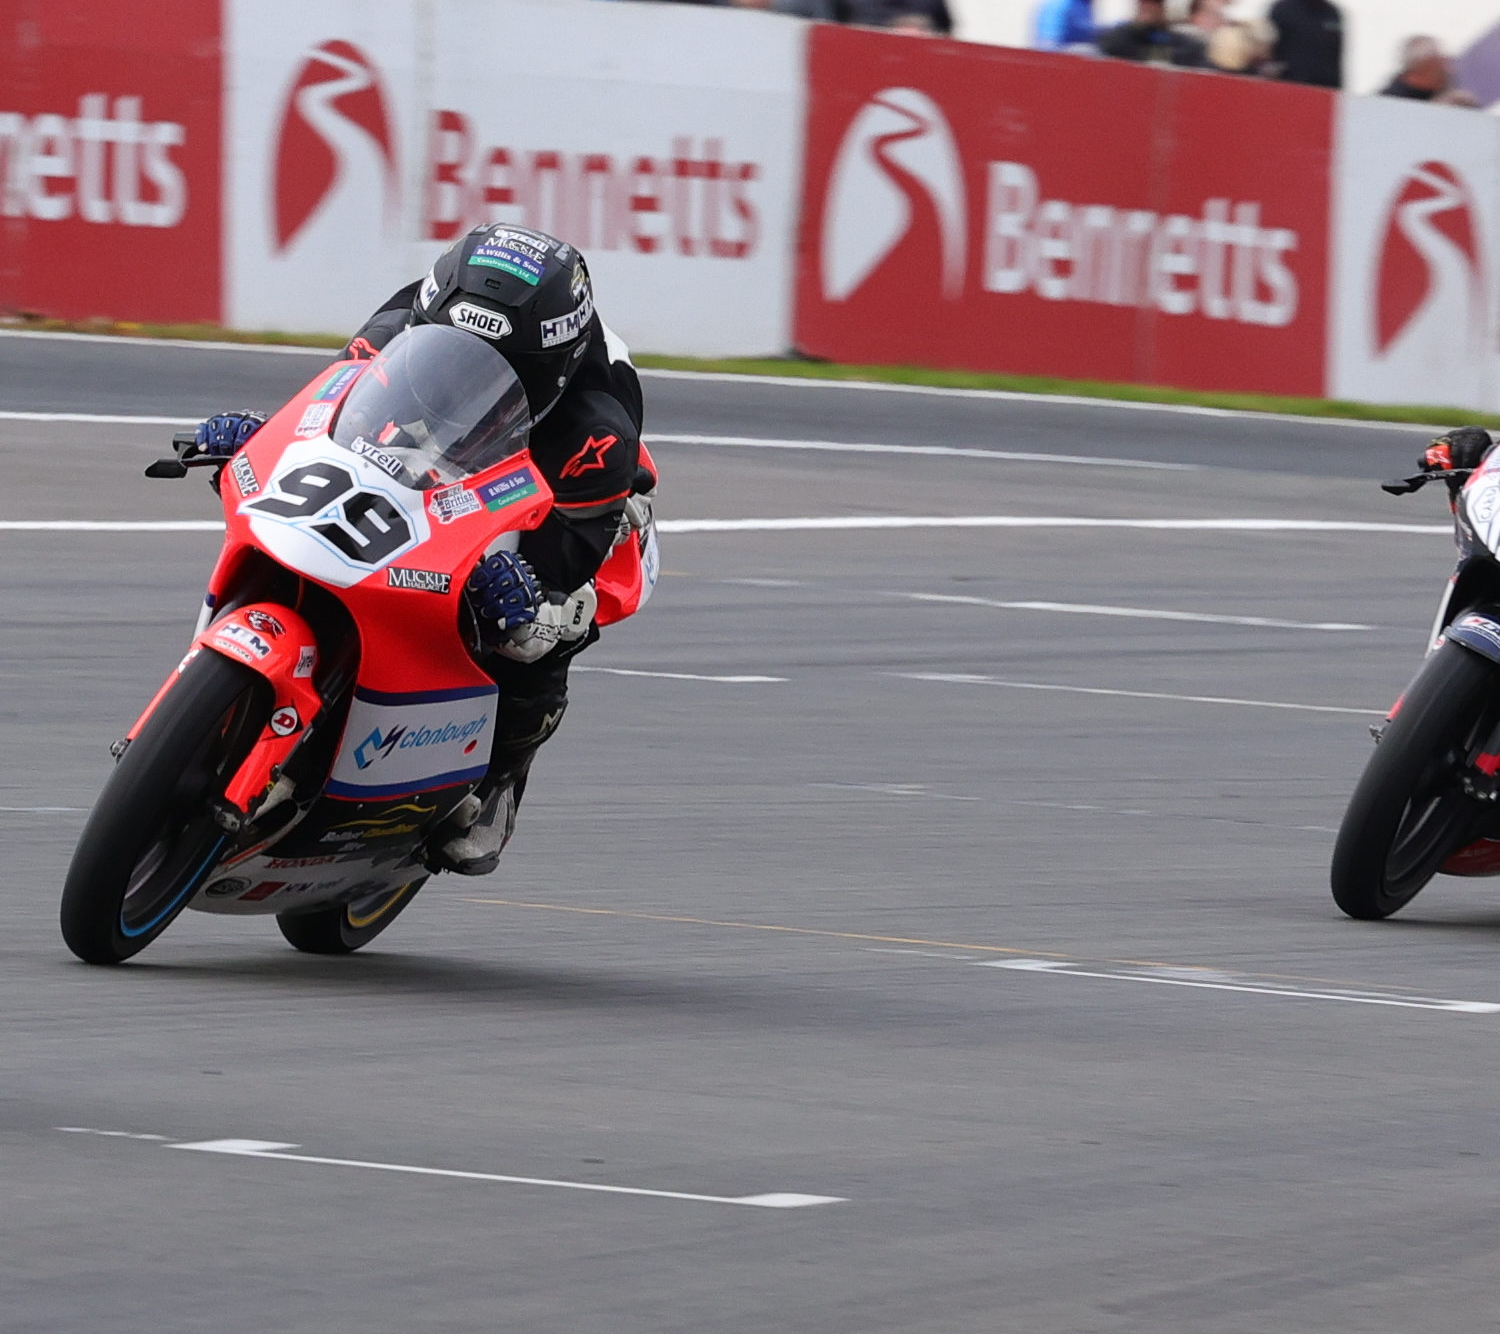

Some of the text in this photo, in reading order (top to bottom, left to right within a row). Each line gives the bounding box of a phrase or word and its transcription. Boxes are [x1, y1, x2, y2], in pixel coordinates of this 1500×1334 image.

[982, 160, 1299, 329] Bennetts
[512, 256, 522, 264] &
[522, 261, 540, 274] Son
[457, 307, 503, 335] SHOEI
[542, 314, 579, 339] HTM
[350, 436, 402, 475] tyrell
[245, 462, 412, 564] 99
[443, 491, 475, 510] British
[387, 567, 451, 594] MUCKLE
[222, 625, 270, 656] HTM
